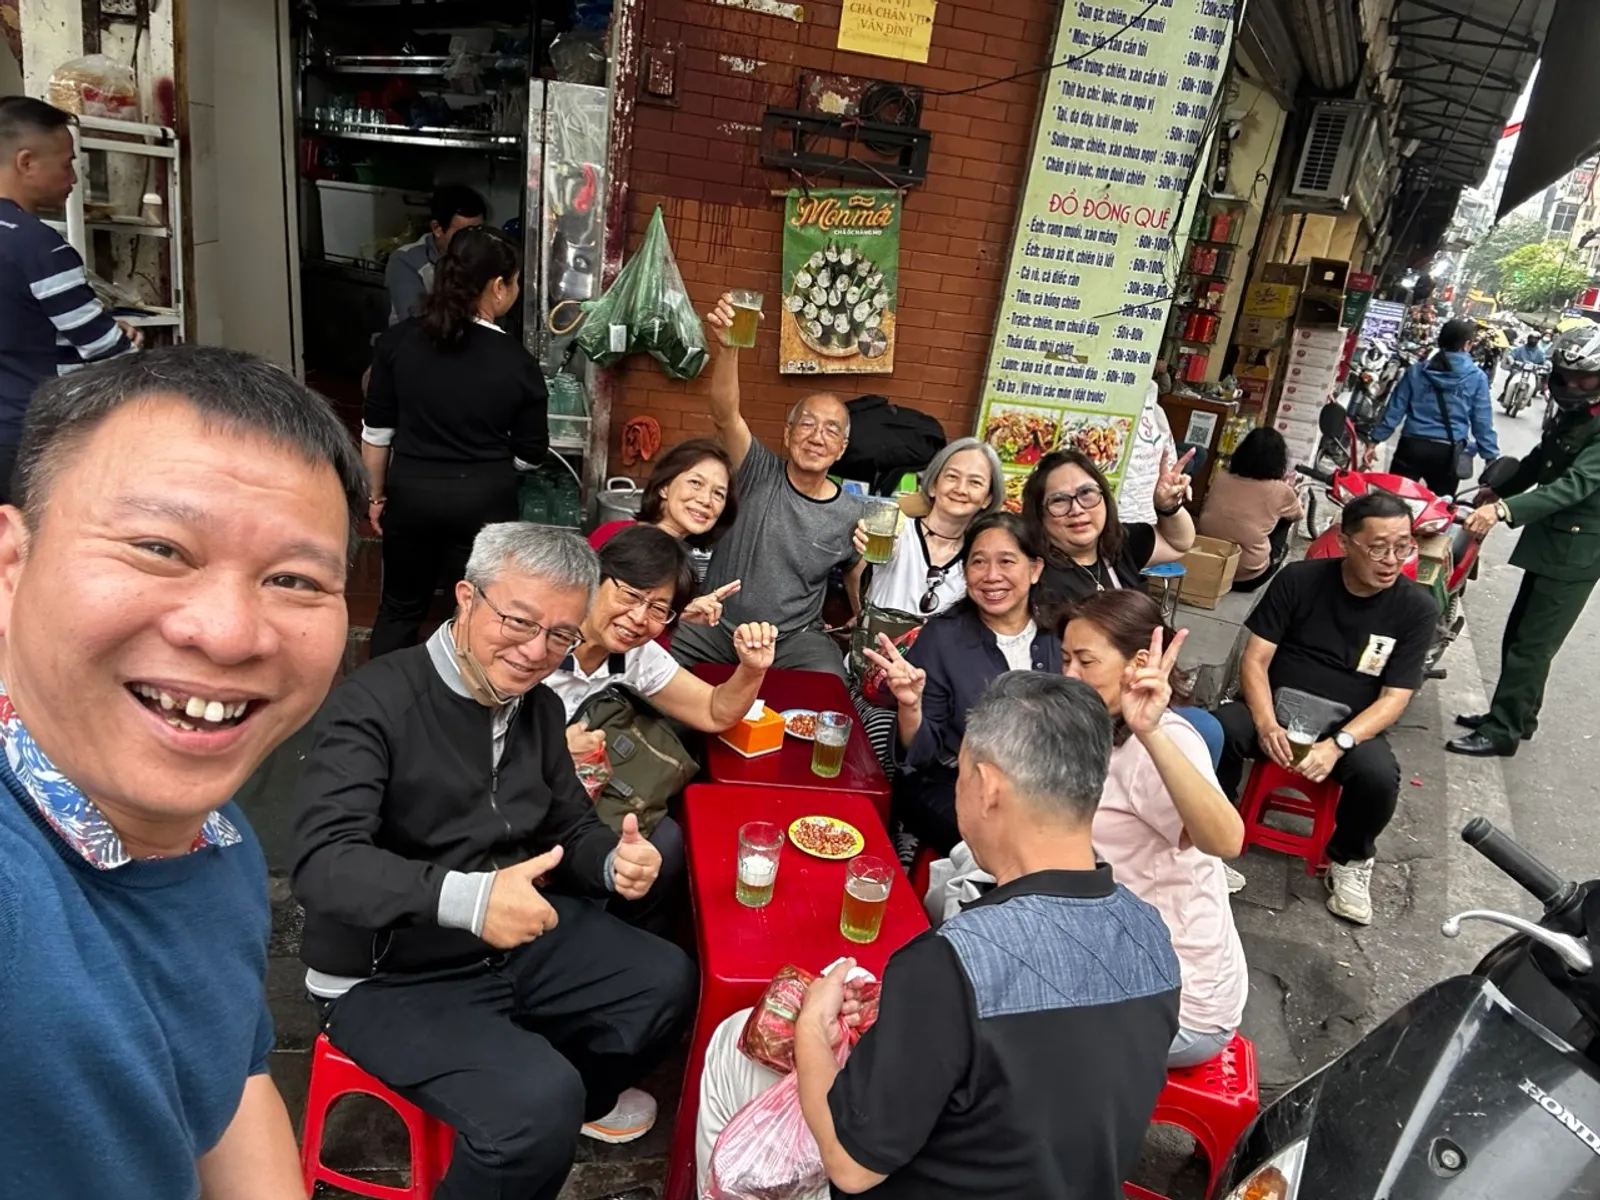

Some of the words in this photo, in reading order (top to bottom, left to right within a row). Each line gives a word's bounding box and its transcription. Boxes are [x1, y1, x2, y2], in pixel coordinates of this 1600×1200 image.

[1049, 189, 1078, 216] ĐỒ
[1083, 194, 1131, 224] ĐỒNG
[1134, 207, 1171, 229] QUÊ
